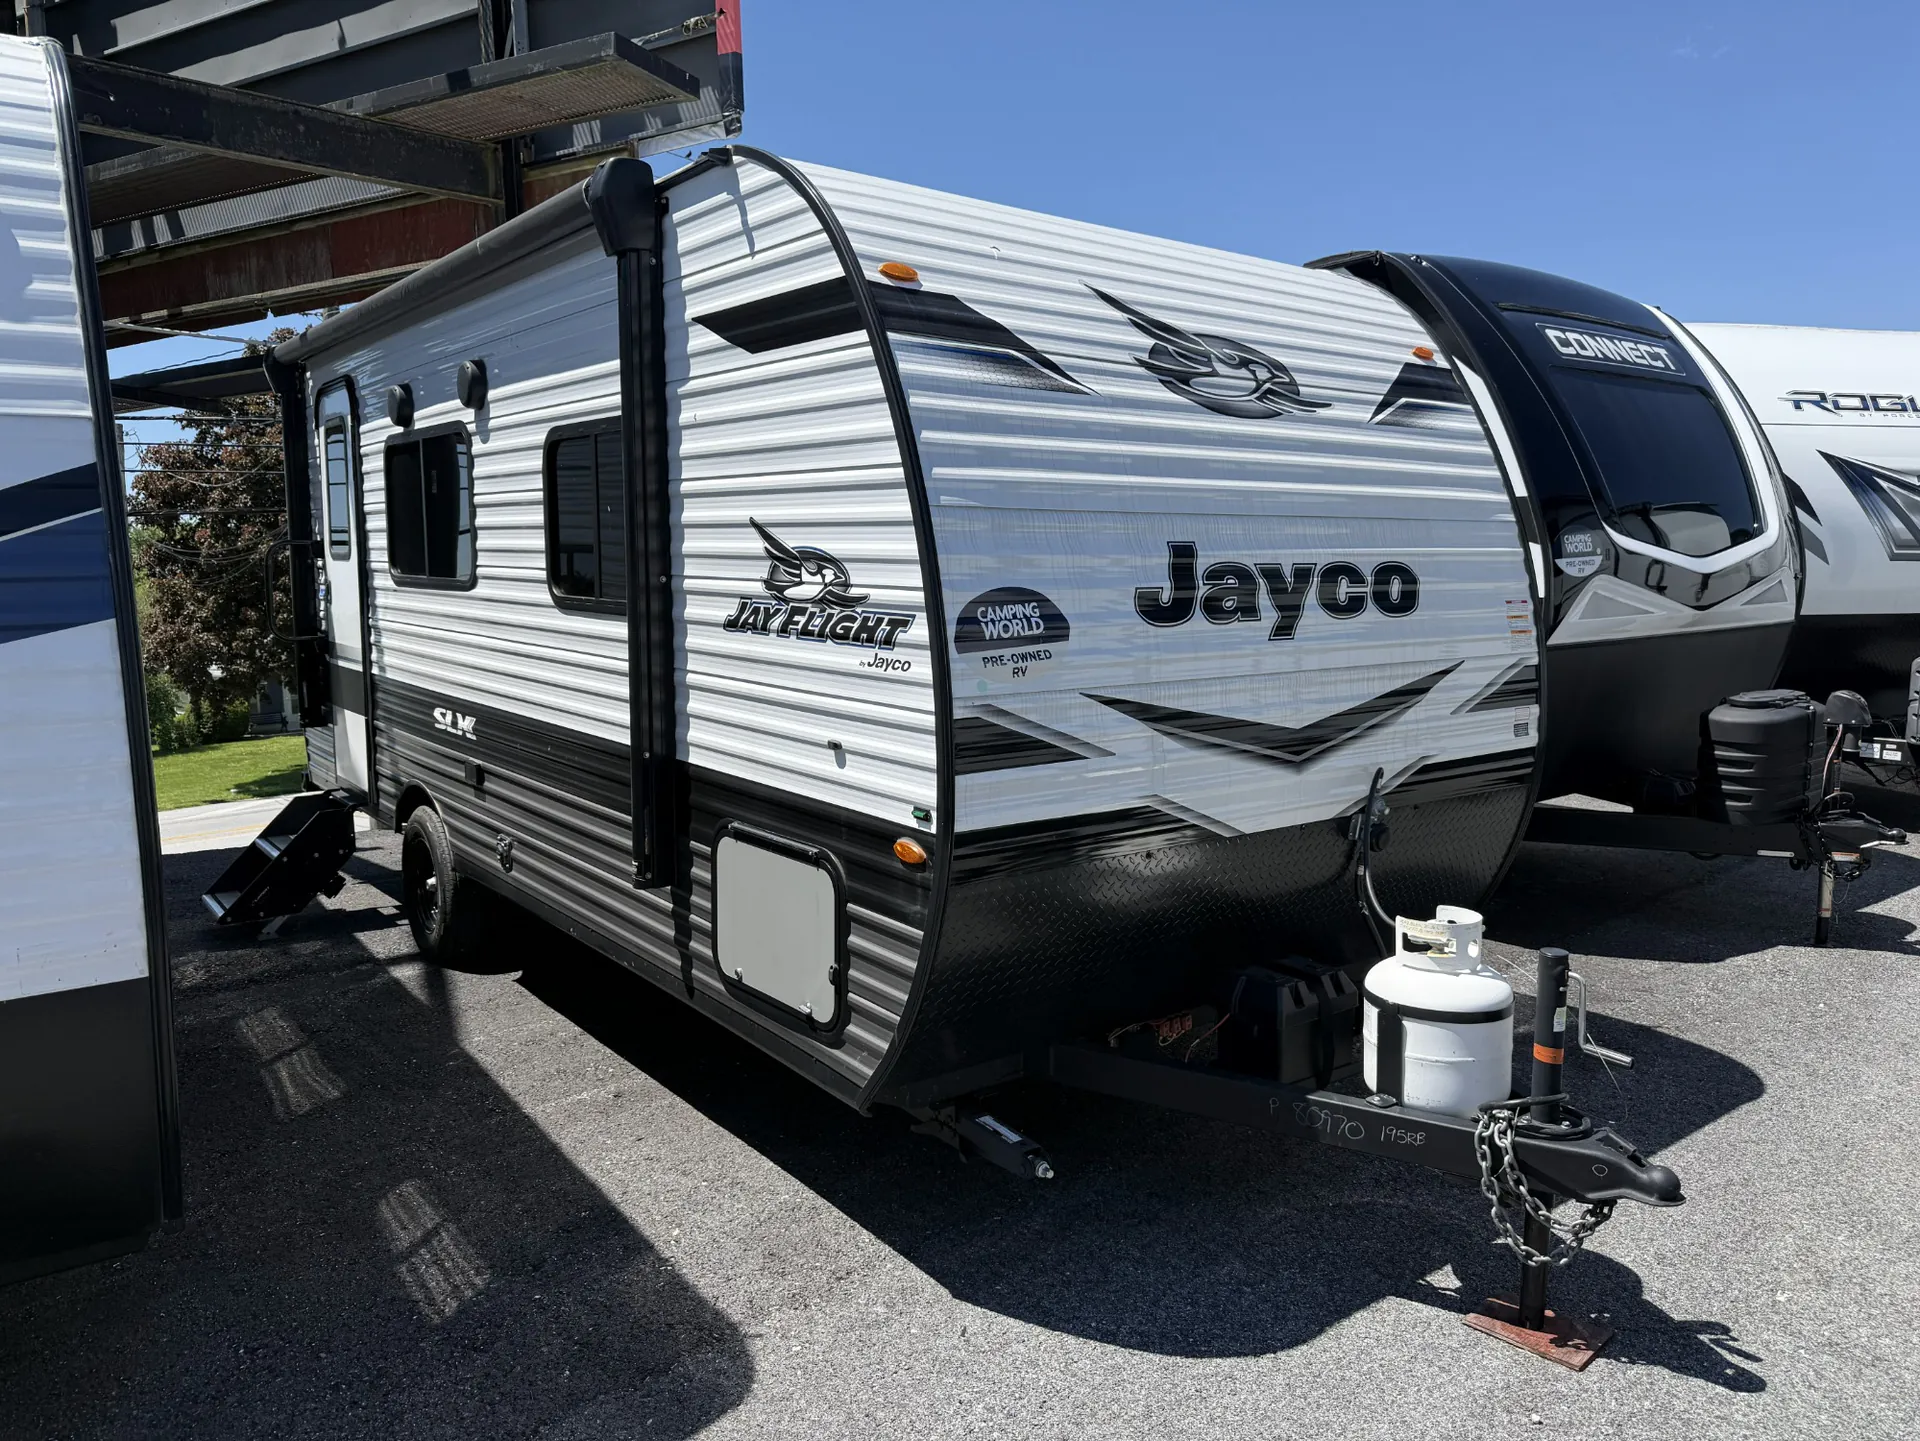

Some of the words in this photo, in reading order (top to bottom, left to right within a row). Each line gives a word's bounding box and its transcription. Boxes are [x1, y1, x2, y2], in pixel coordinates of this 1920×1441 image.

[1544, 328, 1676, 370] CONNECT
[1563, 533, 1592, 544] CAMPING
[1565, 542, 1593, 553] WORLD
[1565, 559, 1596, 568] PRE-OWNED
[1133, 540, 1420, 641] Jayco
[977, 602, 1040, 622] CAMPING
[723, 596, 785, 636] JAY
[777, 603, 917, 651] FLIGHT
[980, 617, 1045, 641] WORLD
[867, 652, 912, 672] Jayco
[981, 649, 1053, 669] PRE-OWNED
[1012, 665, 1029, 679] RV
[433, 707, 478, 741] SLX
[1292, 1102, 1365, 1140] 80970
[1380, 1125, 1426, 1147] 195RB
